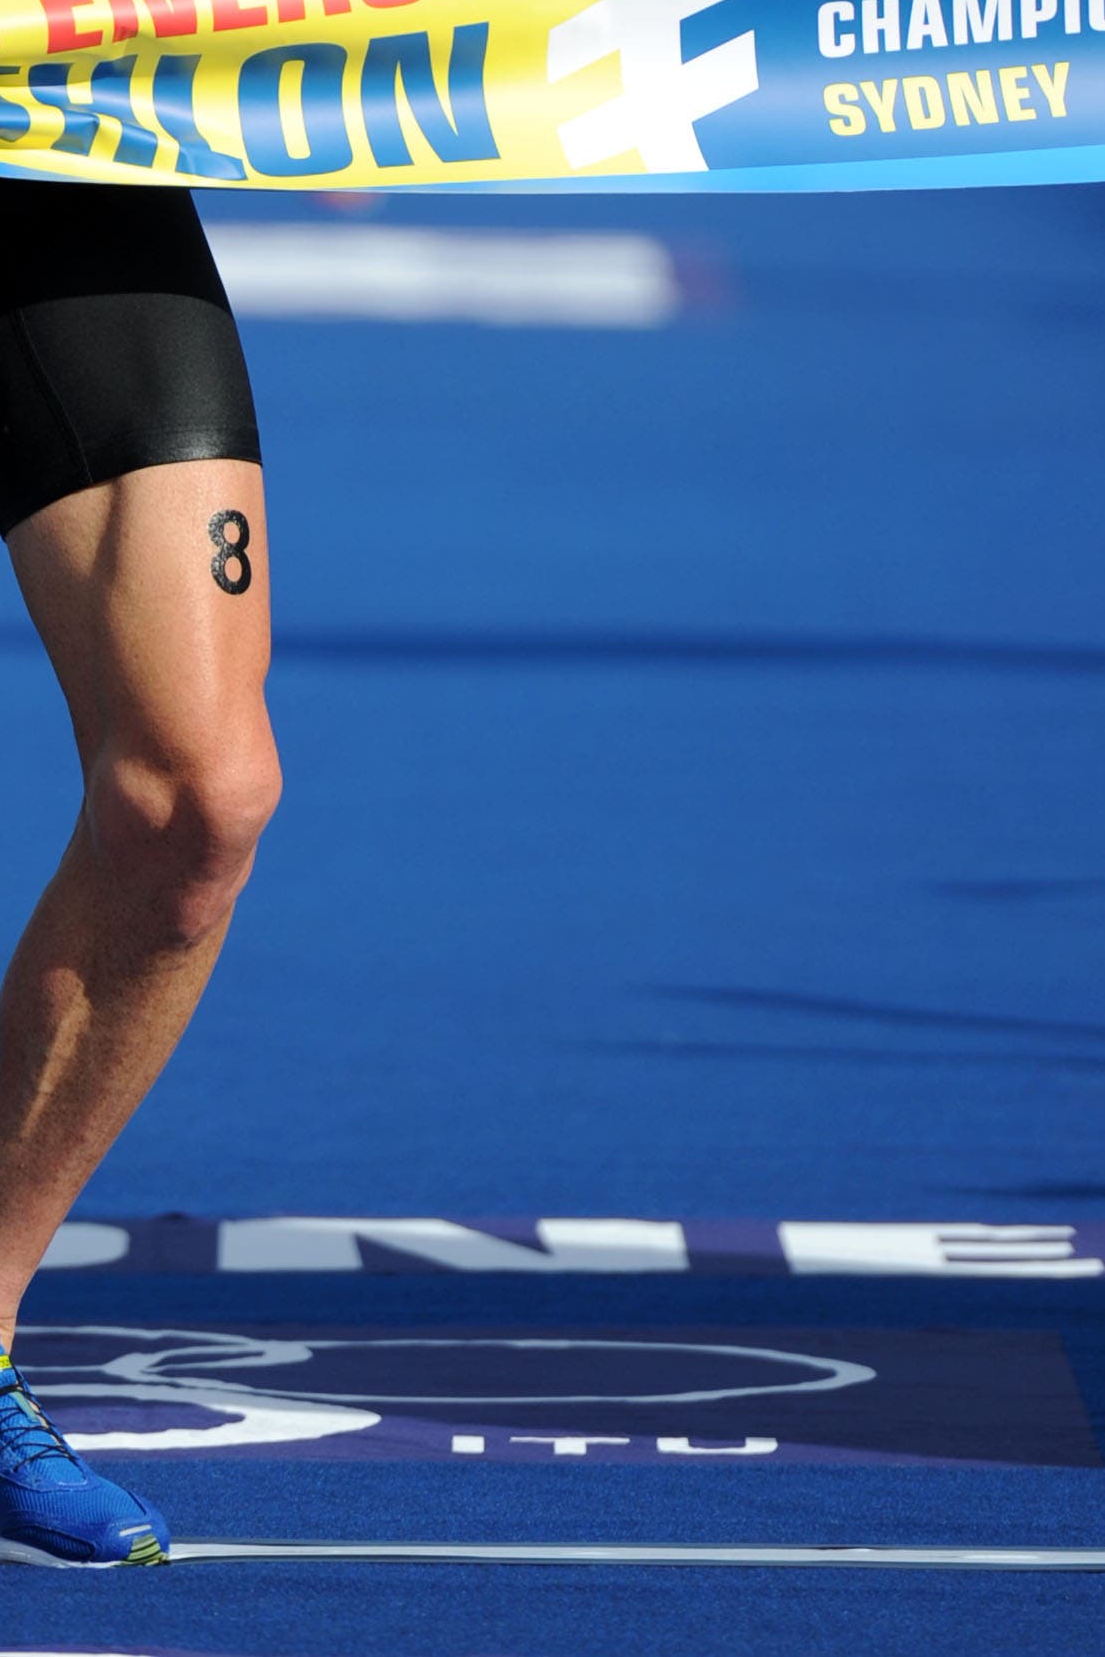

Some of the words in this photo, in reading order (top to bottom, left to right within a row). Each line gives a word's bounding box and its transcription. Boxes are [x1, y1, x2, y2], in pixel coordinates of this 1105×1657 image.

[823, 61, 1070, 137] SYDNEY
[207, 509, 253, 596] 8
[451, 1435, 779, 1456] ITU
